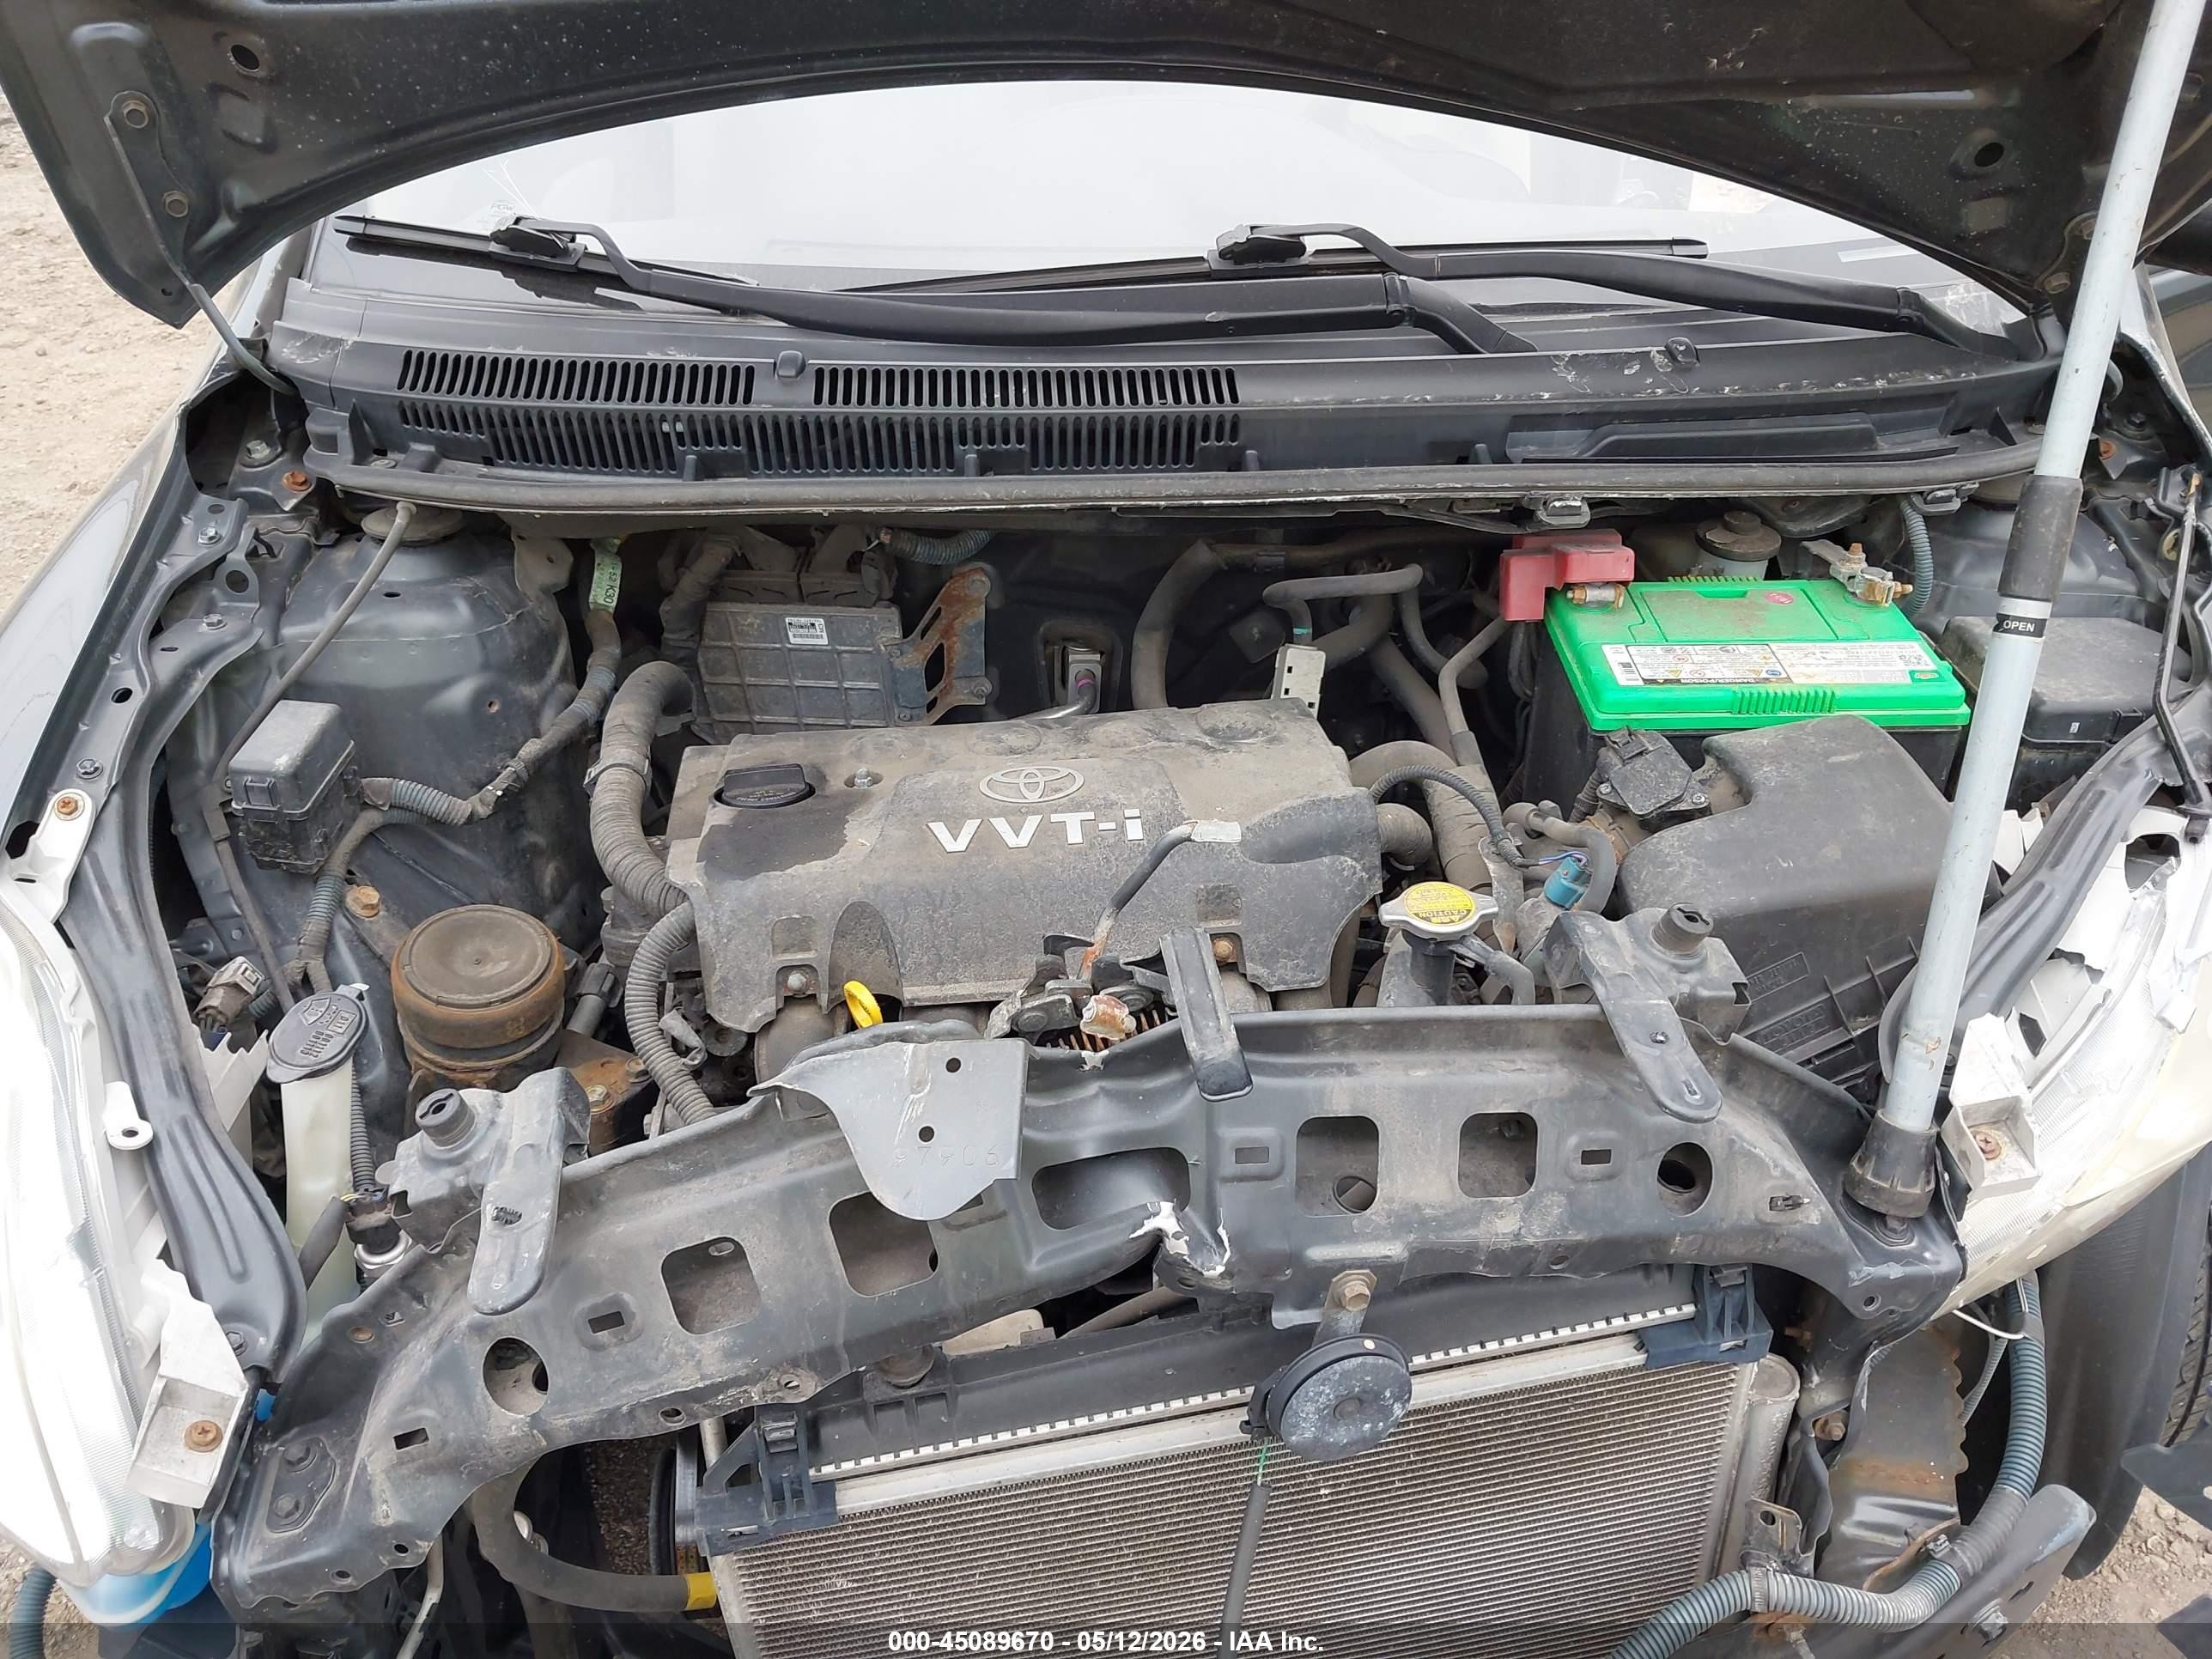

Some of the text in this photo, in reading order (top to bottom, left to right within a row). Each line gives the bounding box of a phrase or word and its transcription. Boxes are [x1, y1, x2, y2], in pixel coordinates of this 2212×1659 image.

[604, 584, 618, 604] K30
[2002, 620, 2035, 633] OPEN
[926, 808, 1145, 854] VVT-i
[1419, 909, 1468, 919] CAUTION
